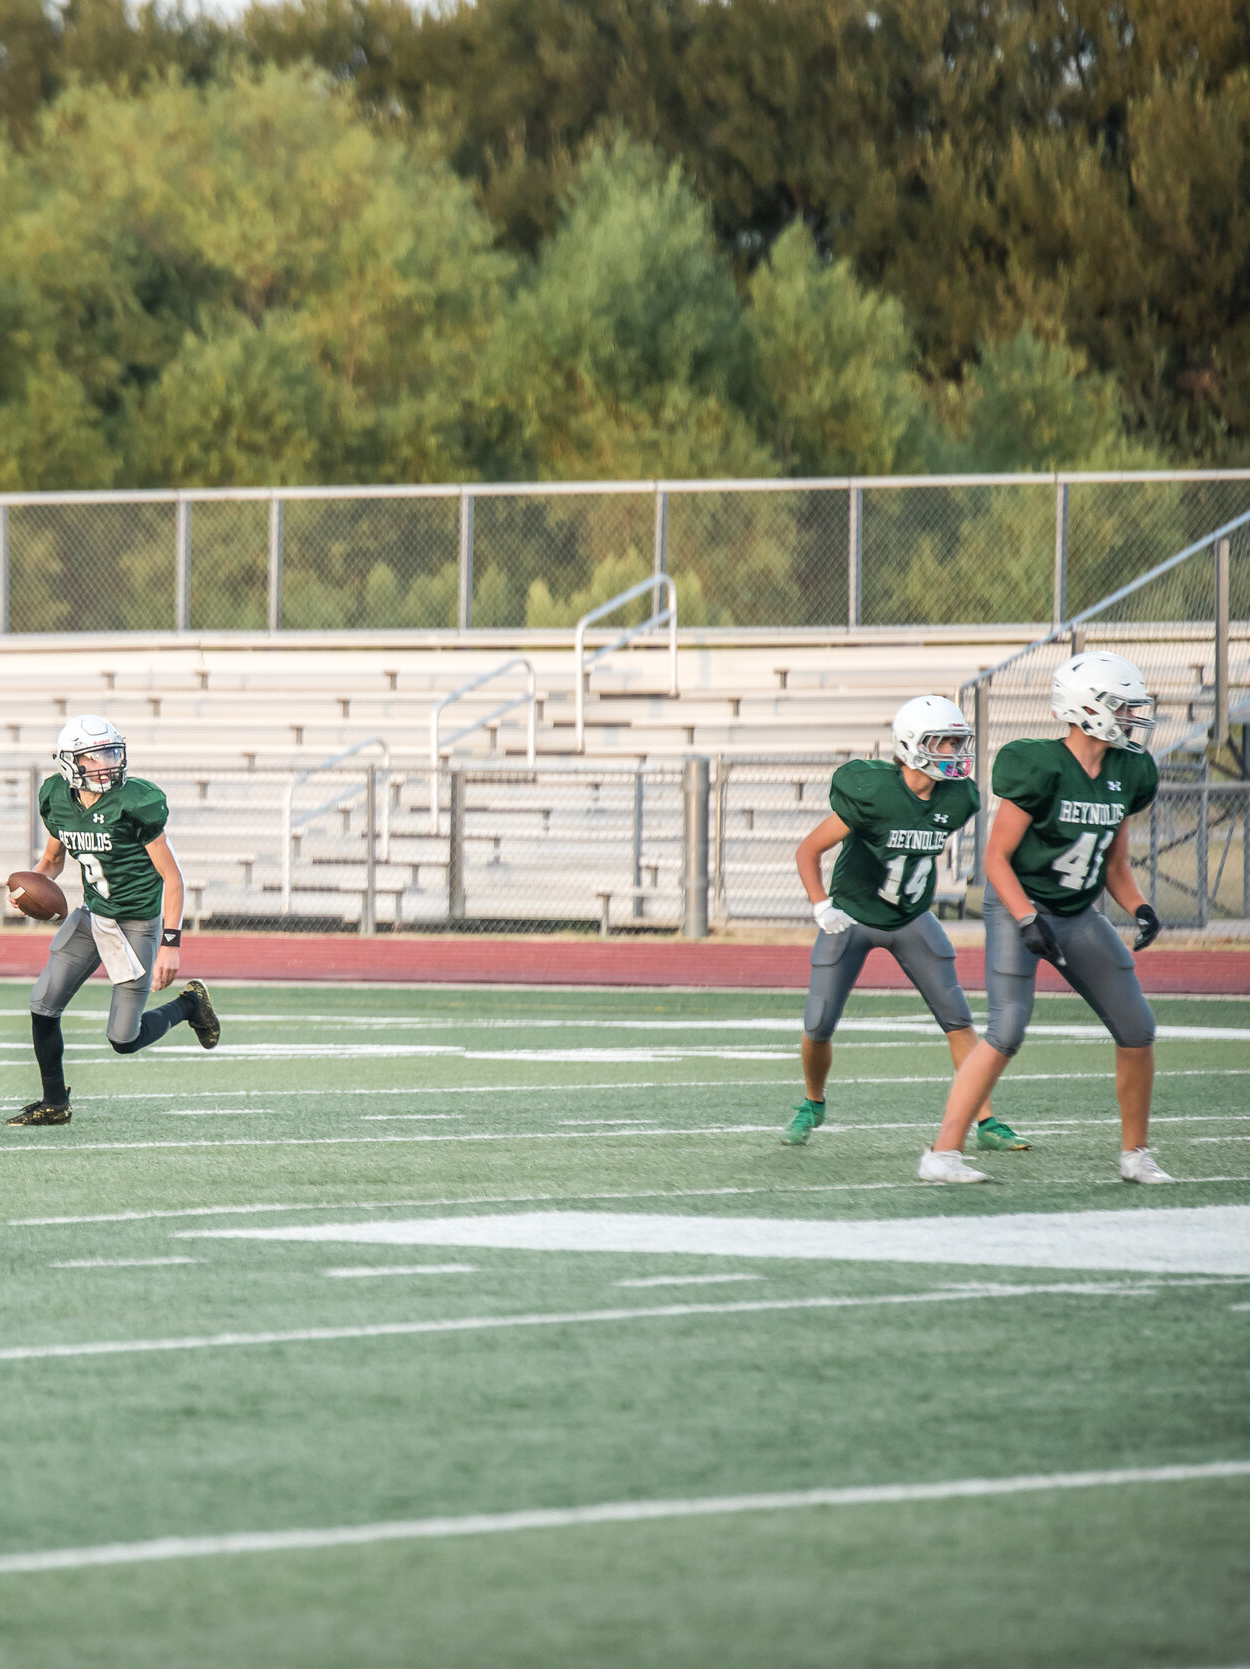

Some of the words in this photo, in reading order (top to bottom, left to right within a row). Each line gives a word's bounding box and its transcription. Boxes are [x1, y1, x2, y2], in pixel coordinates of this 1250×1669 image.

[1059, 800, 1125, 825] REYNOLDS
[58, 830, 112, 851] REYNOLDS
[887, 830, 948, 850] REYNOLDS
[878, 855, 932, 905] 14
